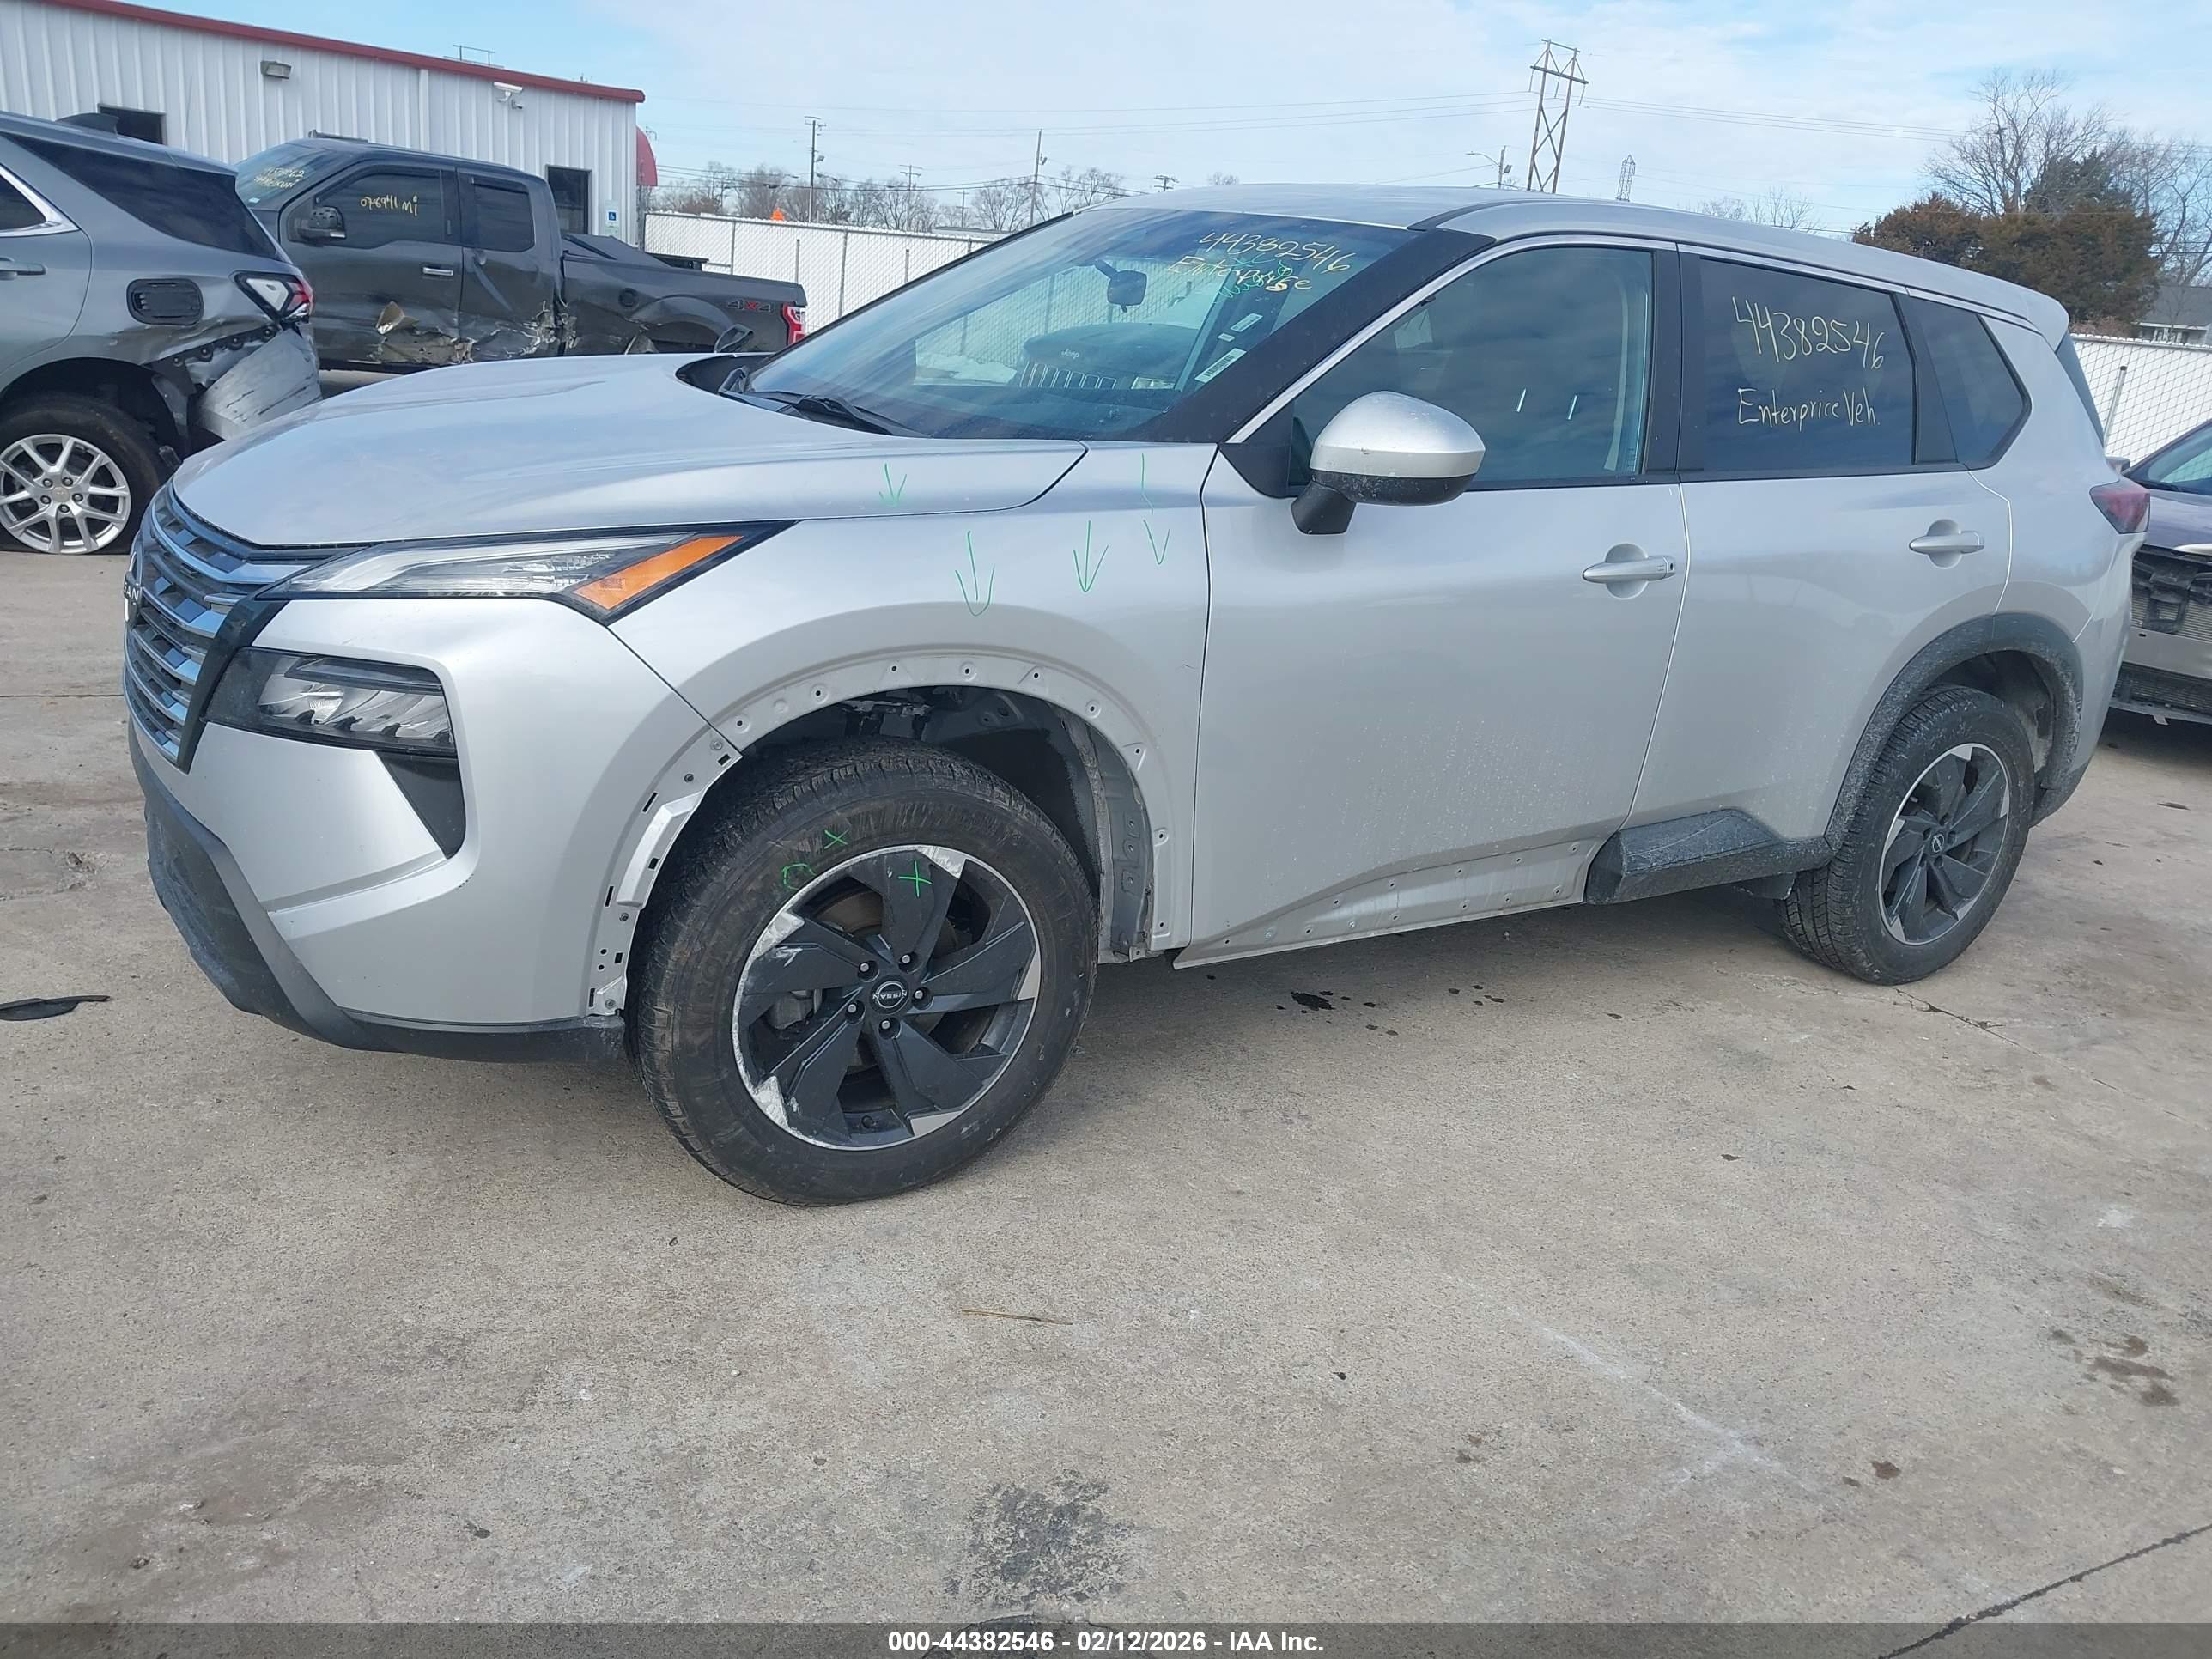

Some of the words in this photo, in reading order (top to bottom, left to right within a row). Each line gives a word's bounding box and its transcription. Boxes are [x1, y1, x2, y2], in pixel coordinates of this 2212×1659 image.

[1199, 232, 1355, 273] 44382546
[1732, 296, 1885, 369] 44382546
[872, 989, 908, 1000] NISSAN
